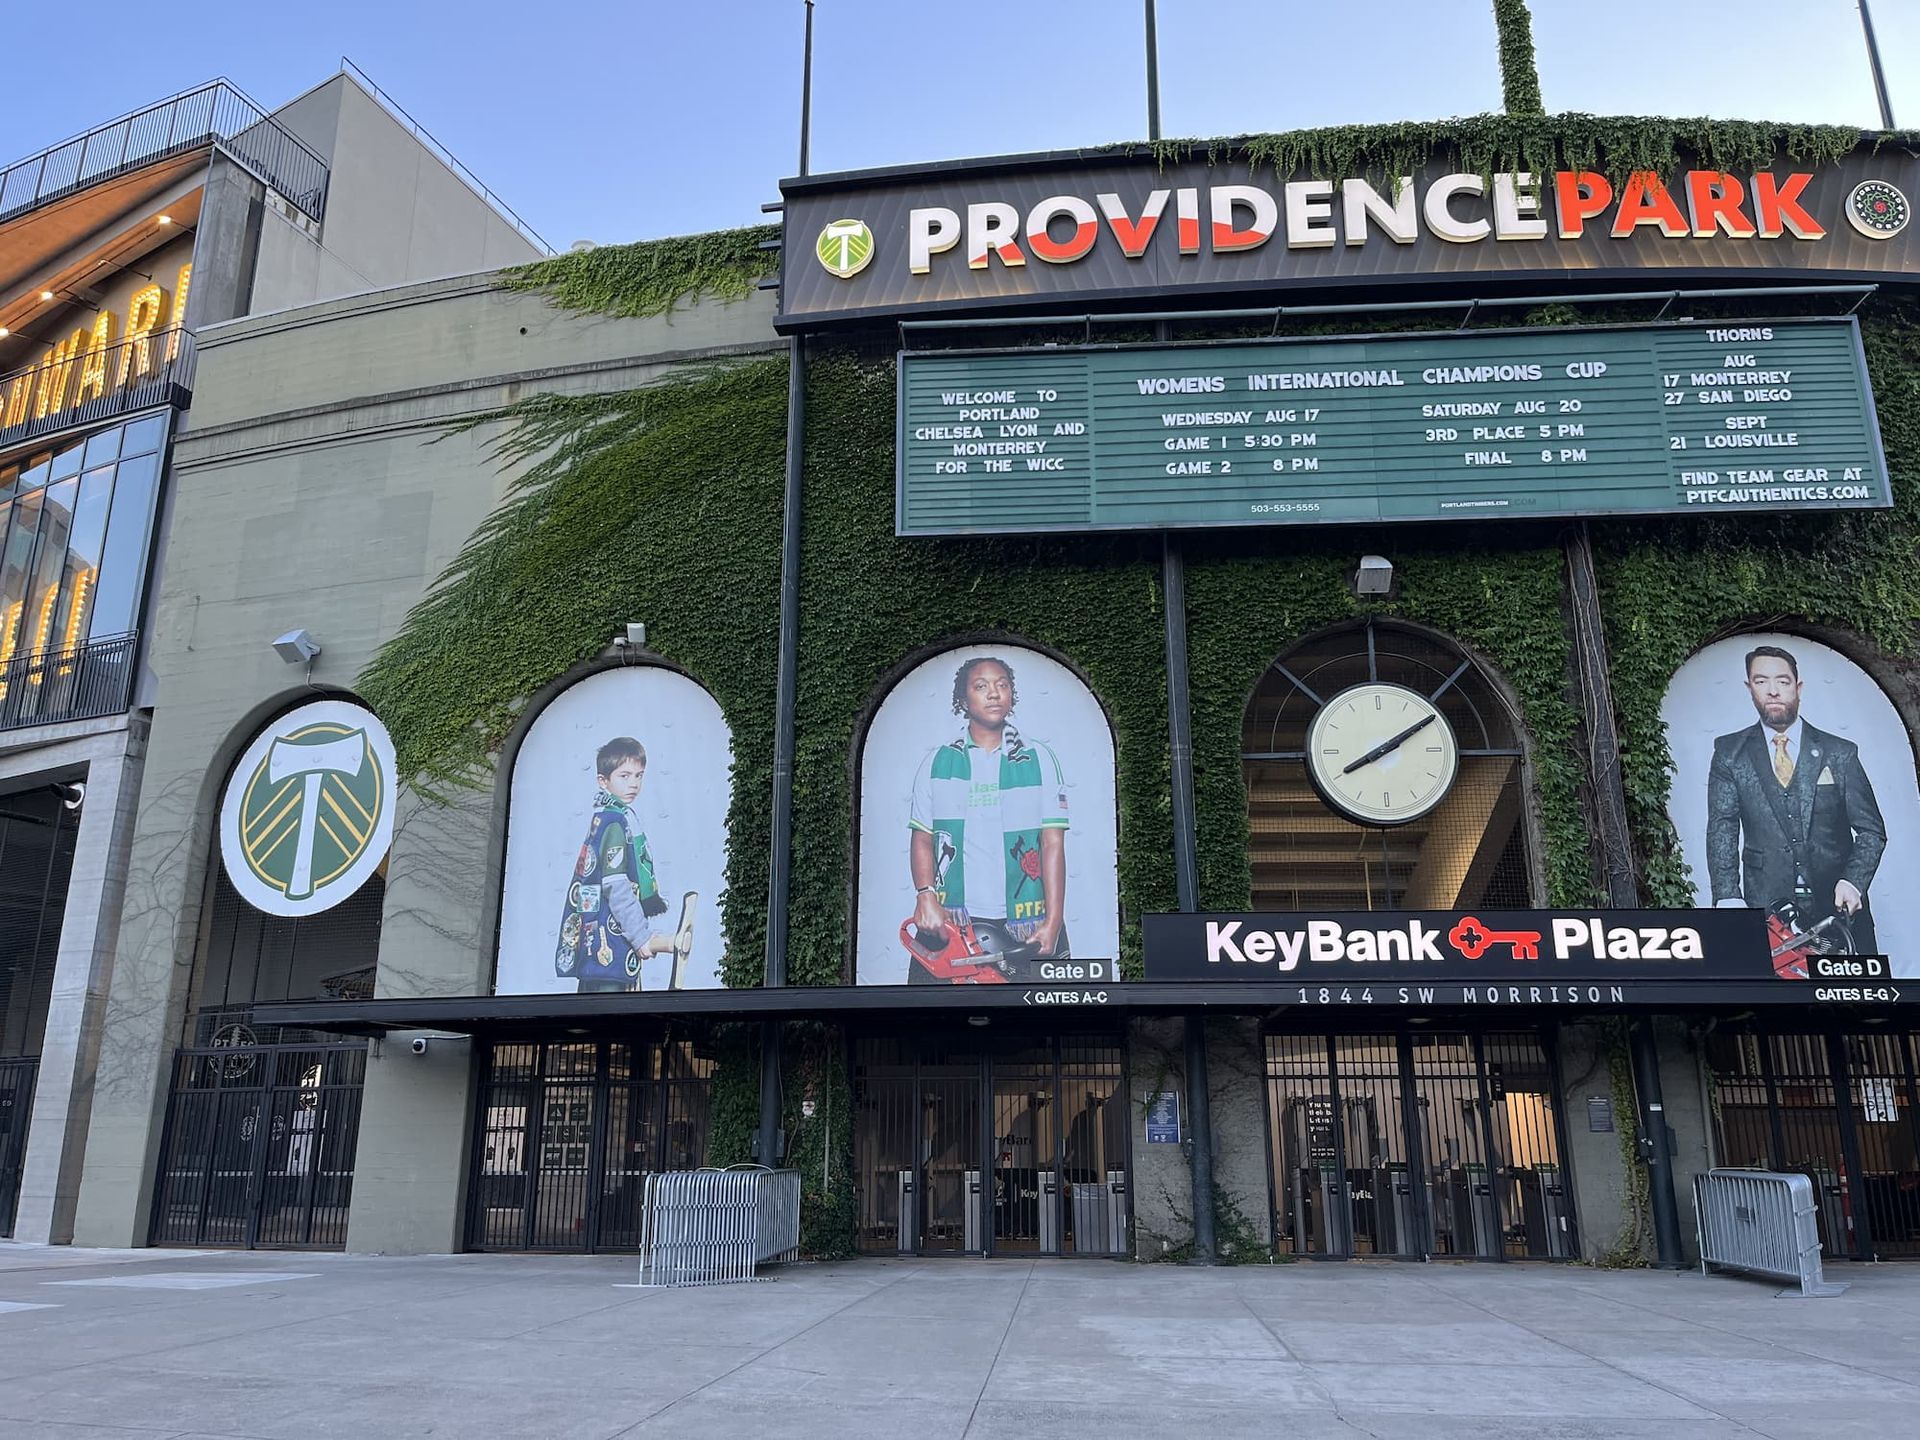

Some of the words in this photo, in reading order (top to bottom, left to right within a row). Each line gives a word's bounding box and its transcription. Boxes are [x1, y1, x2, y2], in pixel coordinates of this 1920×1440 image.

[1856, 184, 1902, 204] PORTLAND
[909, 171, 1548, 275] PROVIDENCE
[1554, 169, 1828, 240] PARK
[1706, 328, 1774, 342] THORNS
[1724, 354, 1756, 368] AUG
[1137, 376, 1226, 395] WOMENS
[1248, 369, 1405, 391] INTERNATIONAL
[1422, 364, 1543, 384] CHAMPIONS
[1565, 361, 1607, 379] CUP
[1663, 374, 1680, 387] 17
[1691, 371, 1792, 386] MONTERREY
[941, 390, 1016, 405] WELCOME
[1036, 389, 1057, 402] TO
[1664, 391, 1685, 405] 27
[1698, 389, 1733, 404] SAN
[1743, 388, 1792, 403] DIEGO
[959, 407, 1040, 421] PORTLAND
[1161, 410, 1253, 427] WEDNESDAY
[1264, 409, 1297, 424] AUG
[1304, 408, 1320, 422] 17
[1422, 401, 1502, 418] SATURDAY
[1514, 400, 1546, 414] AUG
[1559, 399, 1582, 413] 20
[915, 426, 984, 440] CHELSEA
[999, 424, 1038, 438] LYON
[1053, 422, 1085, 436] AND
[1725, 416, 1768, 430] SEPT
[1425, 428, 1459, 442] 3RD
[1473, 426, 1525, 441] PLACE
[1539, 424, 1551, 438] 5
[1558, 423, 1584, 437] PM
[1670, 436, 1687, 450] 21
[1704, 433, 1799, 449] LOUISVILLE
[953, 440, 1047, 457] MONTERREY
[1164, 436, 1210, 451] GAME
[1244, 434, 1283, 448] 5:30
[1290, 433, 1317, 446] PM
[1464, 450, 1513, 465] FINAL
[1541, 449, 1553, 463] 8
[1560, 448, 1587, 462] PM
[935, 461, 968, 474] FOR
[983, 459, 1013, 473] THE
[1026, 458, 1065, 471] WICC
[1165, 461, 1212, 475] GAME
[1220, 460, 1232, 473] 2
[1273, 458, 1284, 471] 8
[1292, 457, 1319, 471] PM
[1681, 471, 1719, 485] FIND
[1726, 470, 1775, 484] TEAM
[1783, 468, 1829, 482] GEAR
[1842, 467, 1863, 481] AT
[1686, 485, 1870, 504] PTFCAUTHENTICS.COM
[1251, 502, 1321, 513] 503-553-5555
[1015, 900, 1046, 919] PTF
[1205, 919, 1445, 972] KeyBank
[1551, 918, 1704, 960] Plaza
[1040, 962, 1087, 980] Gate
[1089, 963, 1103, 979] D
[1816, 959, 1860, 976] Gate
[1864, 958, 1882, 975] D
[1034, 991, 1080, 1004] GATES
[1081, 991, 1108, 1003] A-C
[1298, 987, 1374, 1004] 1844
[1399, 987, 1436, 1003] SW
[1463, 986, 1625, 1003] MORRISON
[1815, 988, 1861, 1001] GATES
[1863, 987, 1889, 1000] E-G
